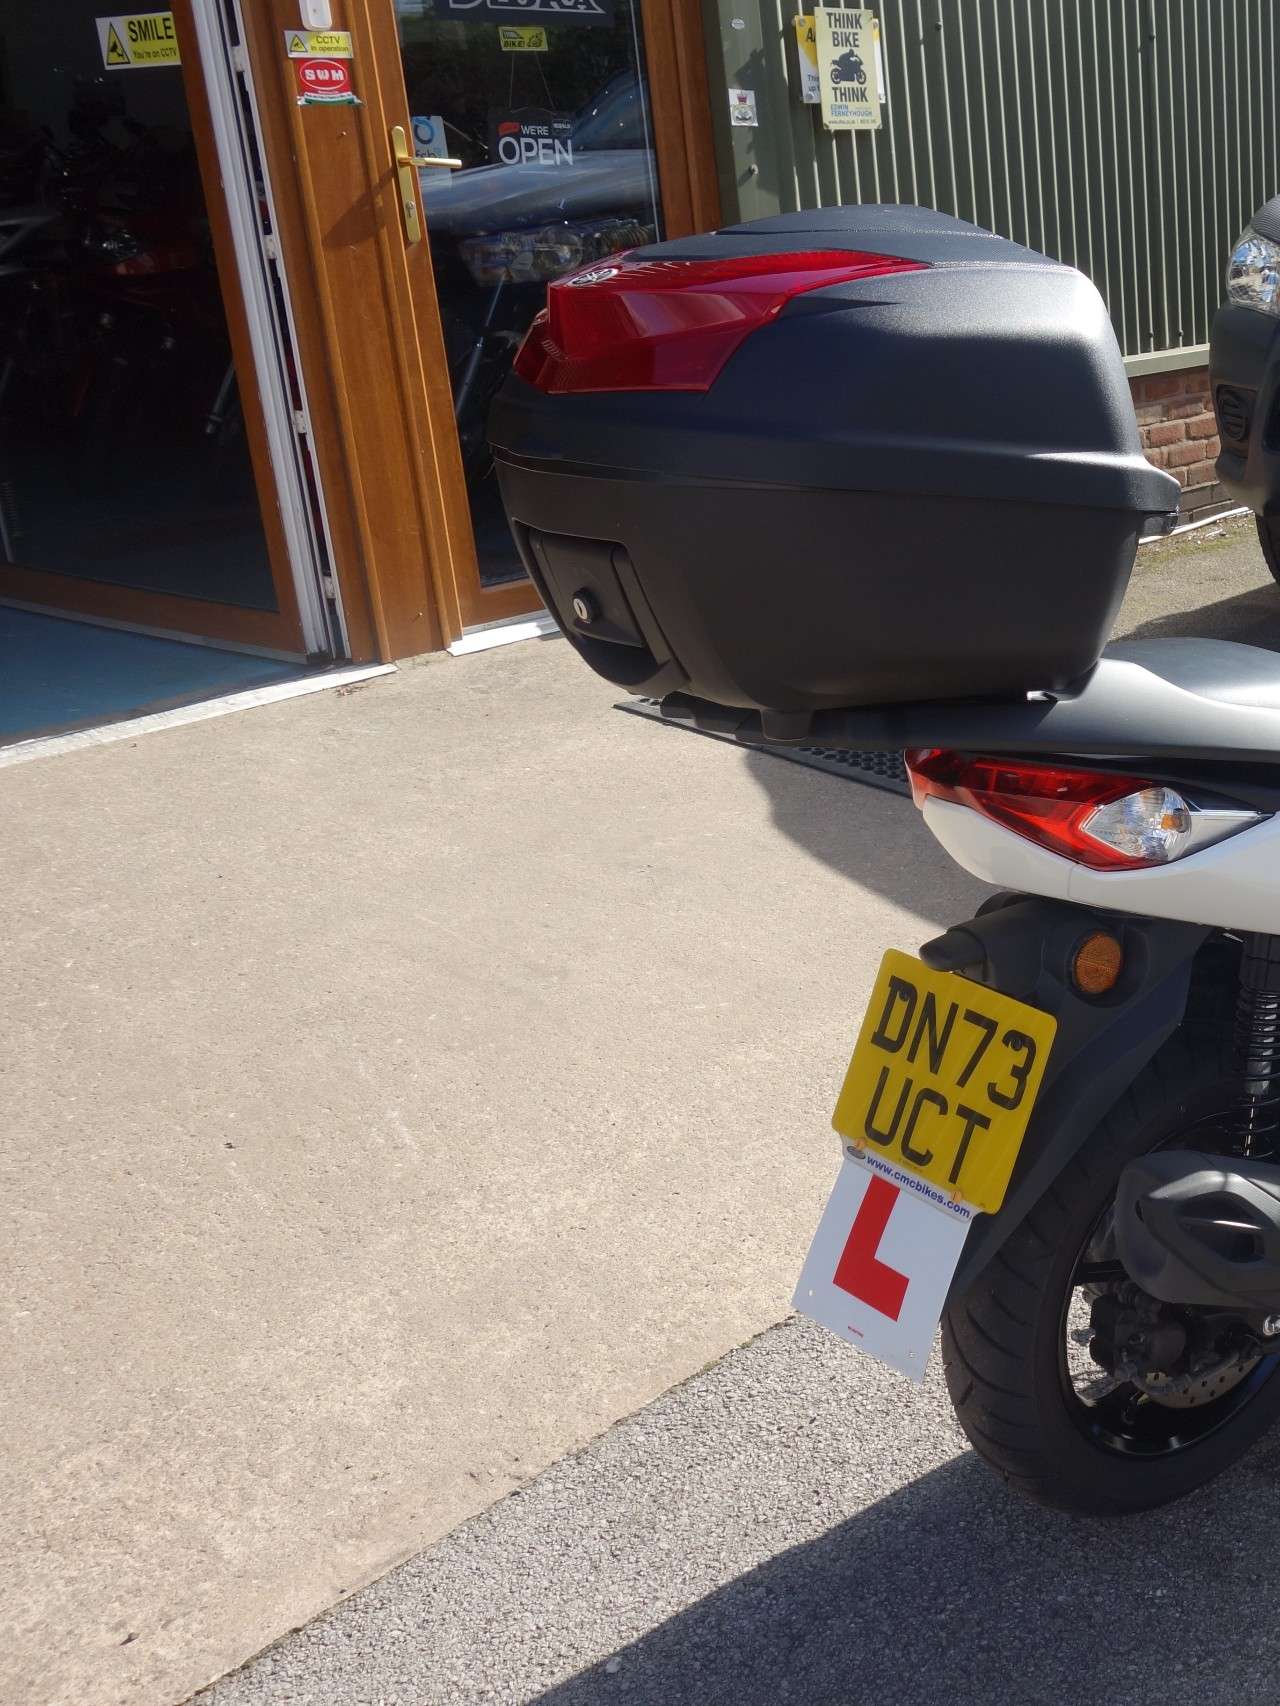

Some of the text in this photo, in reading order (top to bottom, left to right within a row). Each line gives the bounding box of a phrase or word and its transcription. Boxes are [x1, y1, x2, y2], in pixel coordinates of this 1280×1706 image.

[127, 17, 174, 42] SMILE
[826, 12, 862, 29] THINK
[316, 35, 340, 44] CCTV
[832, 31, 859, 48] BIKE
[832, 86, 868, 102] THINK
[498, 136, 573, 165] OPEN
[870, 975, 1037, 1110] DN73
[864, 1066, 992, 1184] UCT
[866, 1155, 970, 1219] www.cmcbikes.com
[832, 1173, 910, 1322] L
